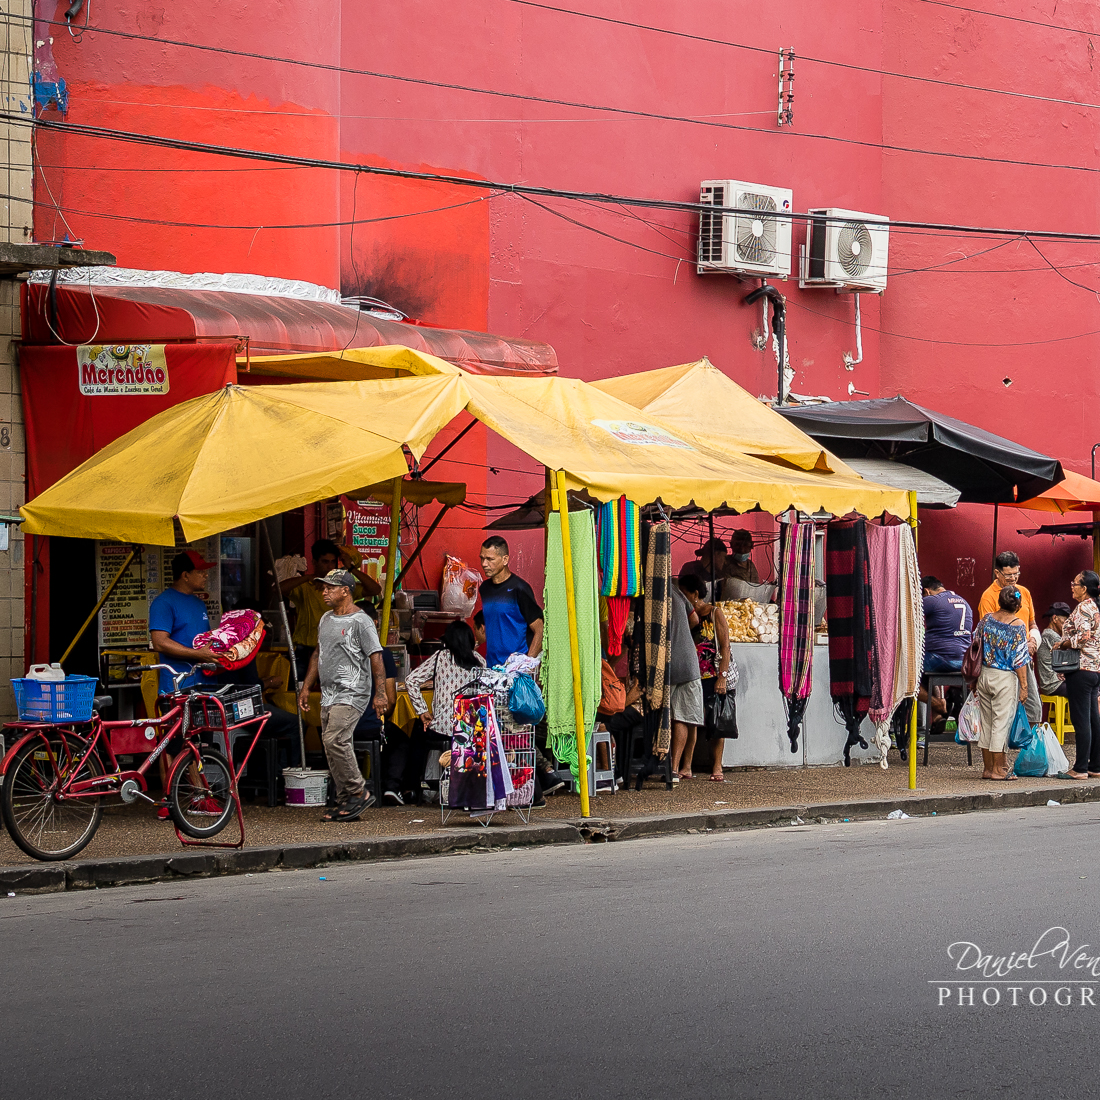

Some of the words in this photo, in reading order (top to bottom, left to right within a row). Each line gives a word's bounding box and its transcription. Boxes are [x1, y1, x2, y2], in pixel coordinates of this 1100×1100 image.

[81, 361, 166, 385] Merendão
[83, 386, 95, 394] Café
[352, 522, 377, 535] Sucos
[352, 534, 389, 547] Naturais
[953, 603, 967, 631] 7
